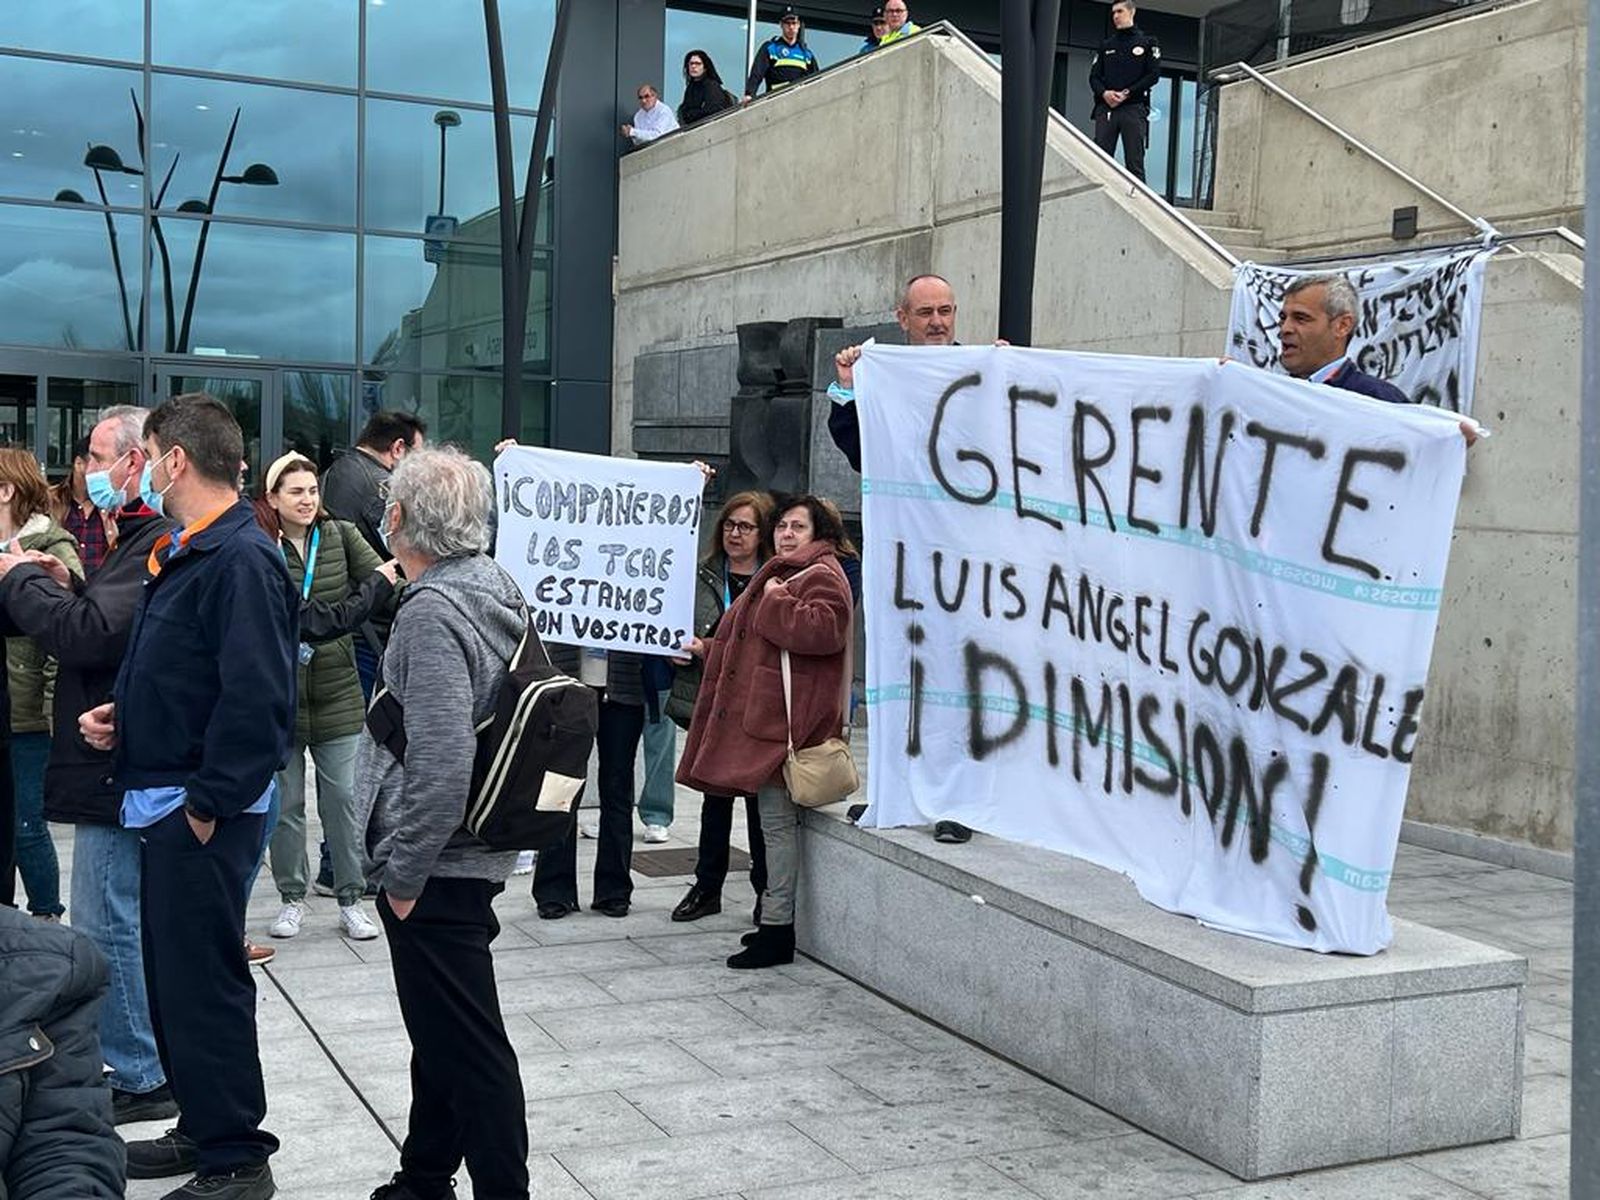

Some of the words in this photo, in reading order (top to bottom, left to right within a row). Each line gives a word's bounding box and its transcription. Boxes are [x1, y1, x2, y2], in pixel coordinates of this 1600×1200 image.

[502, 472, 700, 536] ¡COMPAÑEROS!
[927, 372, 1407, 580] GERENTE
[526, 531, 583, 571] LOS
[598, 543, 675, 582] TCAE
[535, 574, 666, 616] ESTAMOS
[892, 540, 1027, 621] LUIS
[1041, 563, 1179, 674] ANGEL
[571, 613, 686, 650] VOSOTROS
